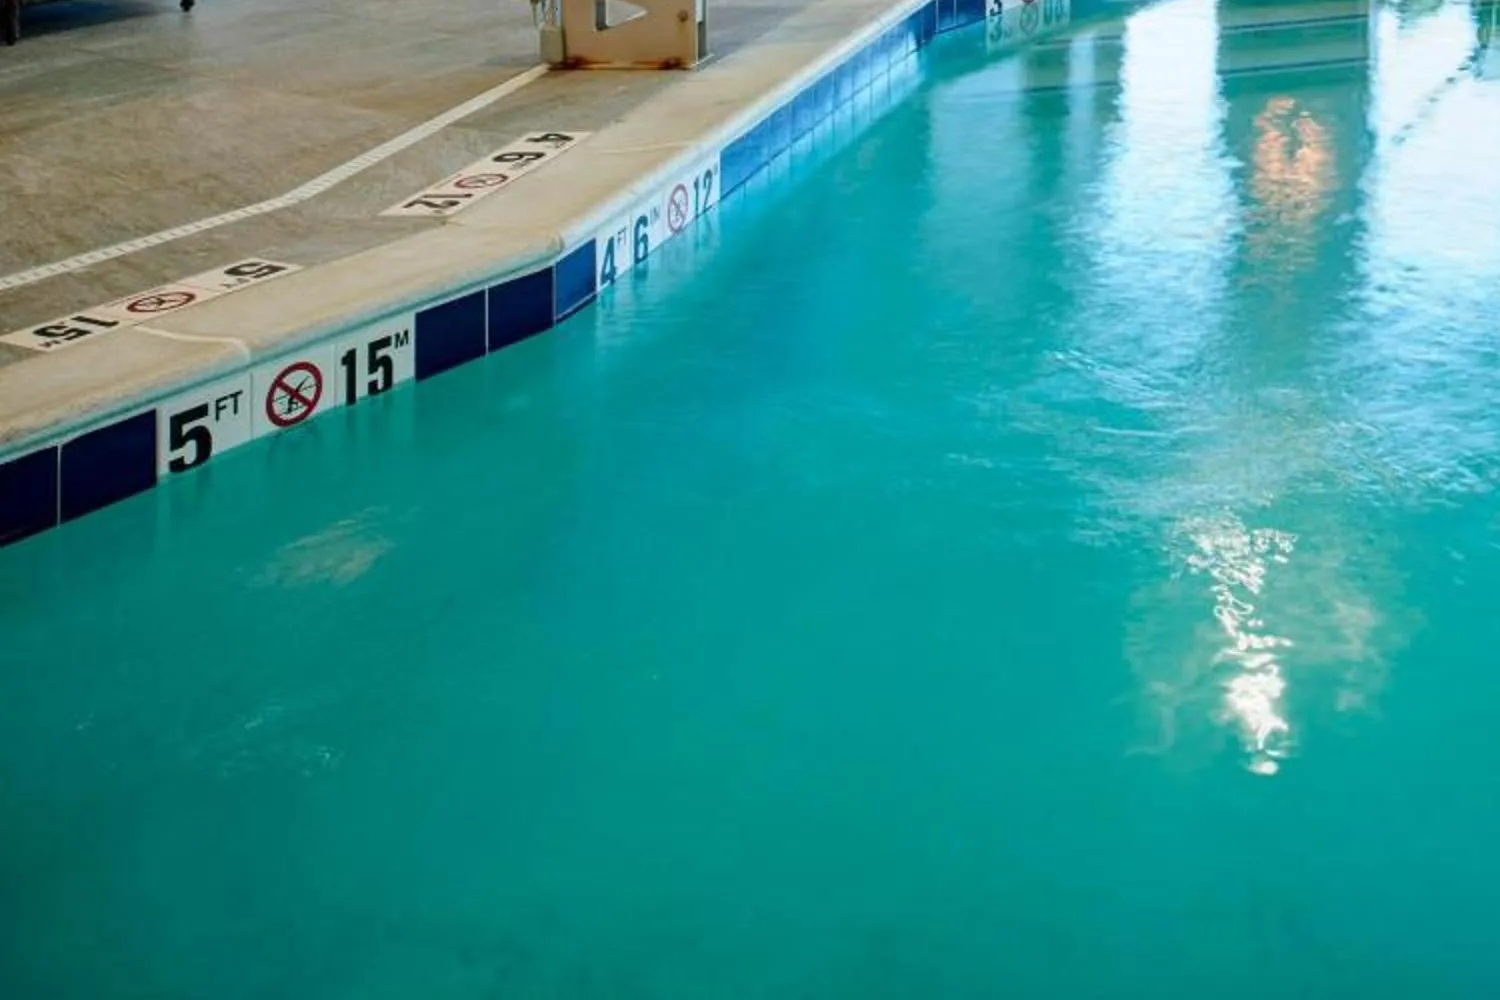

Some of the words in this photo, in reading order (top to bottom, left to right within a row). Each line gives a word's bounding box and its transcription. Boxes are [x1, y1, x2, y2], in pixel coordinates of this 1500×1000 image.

[402, 193, 474, 209] 12
[600, 235, 616, 287] 4
[634, 214, 649, 265] 6
[694, 167, 713, 219] 12
[223, 261, 288, 279] 5
[32, 315, 120, 341] 15
[168, 402, 213, 474] 5
[215, 390, 243, 423] FT
[341, 335, 394, 407] 15
